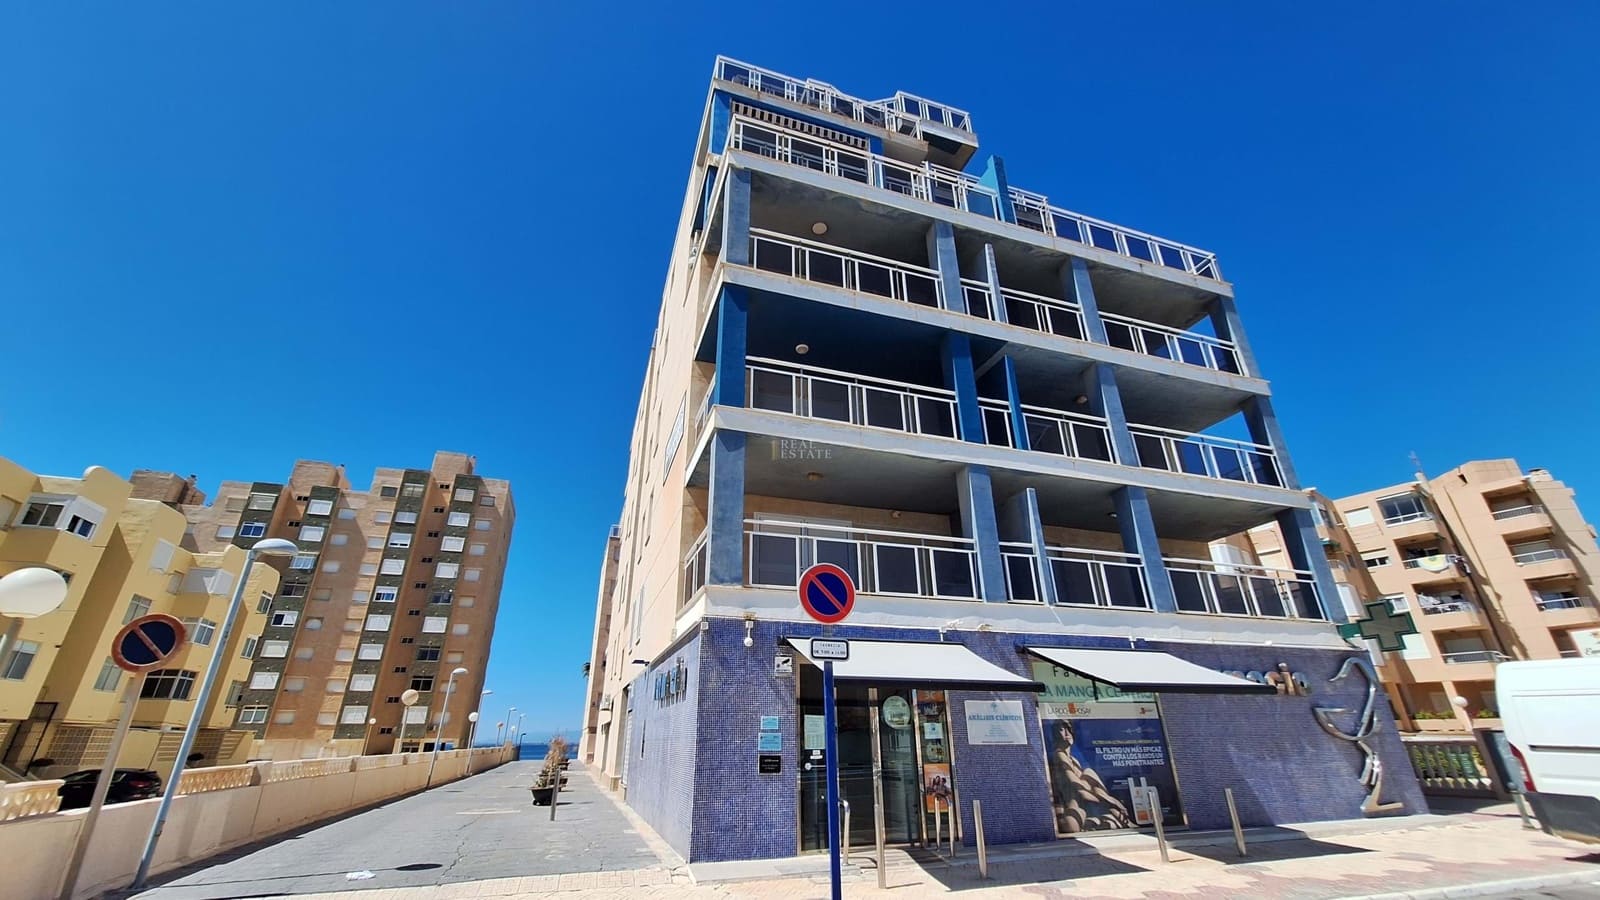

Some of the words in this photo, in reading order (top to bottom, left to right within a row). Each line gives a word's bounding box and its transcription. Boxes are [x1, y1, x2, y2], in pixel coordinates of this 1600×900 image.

[1143, 745, 1162, 753] EFICAZ
[1103, 753, 1126, 761] CONTRA
[1126, 759, 1165, 767] PENETRANTES
